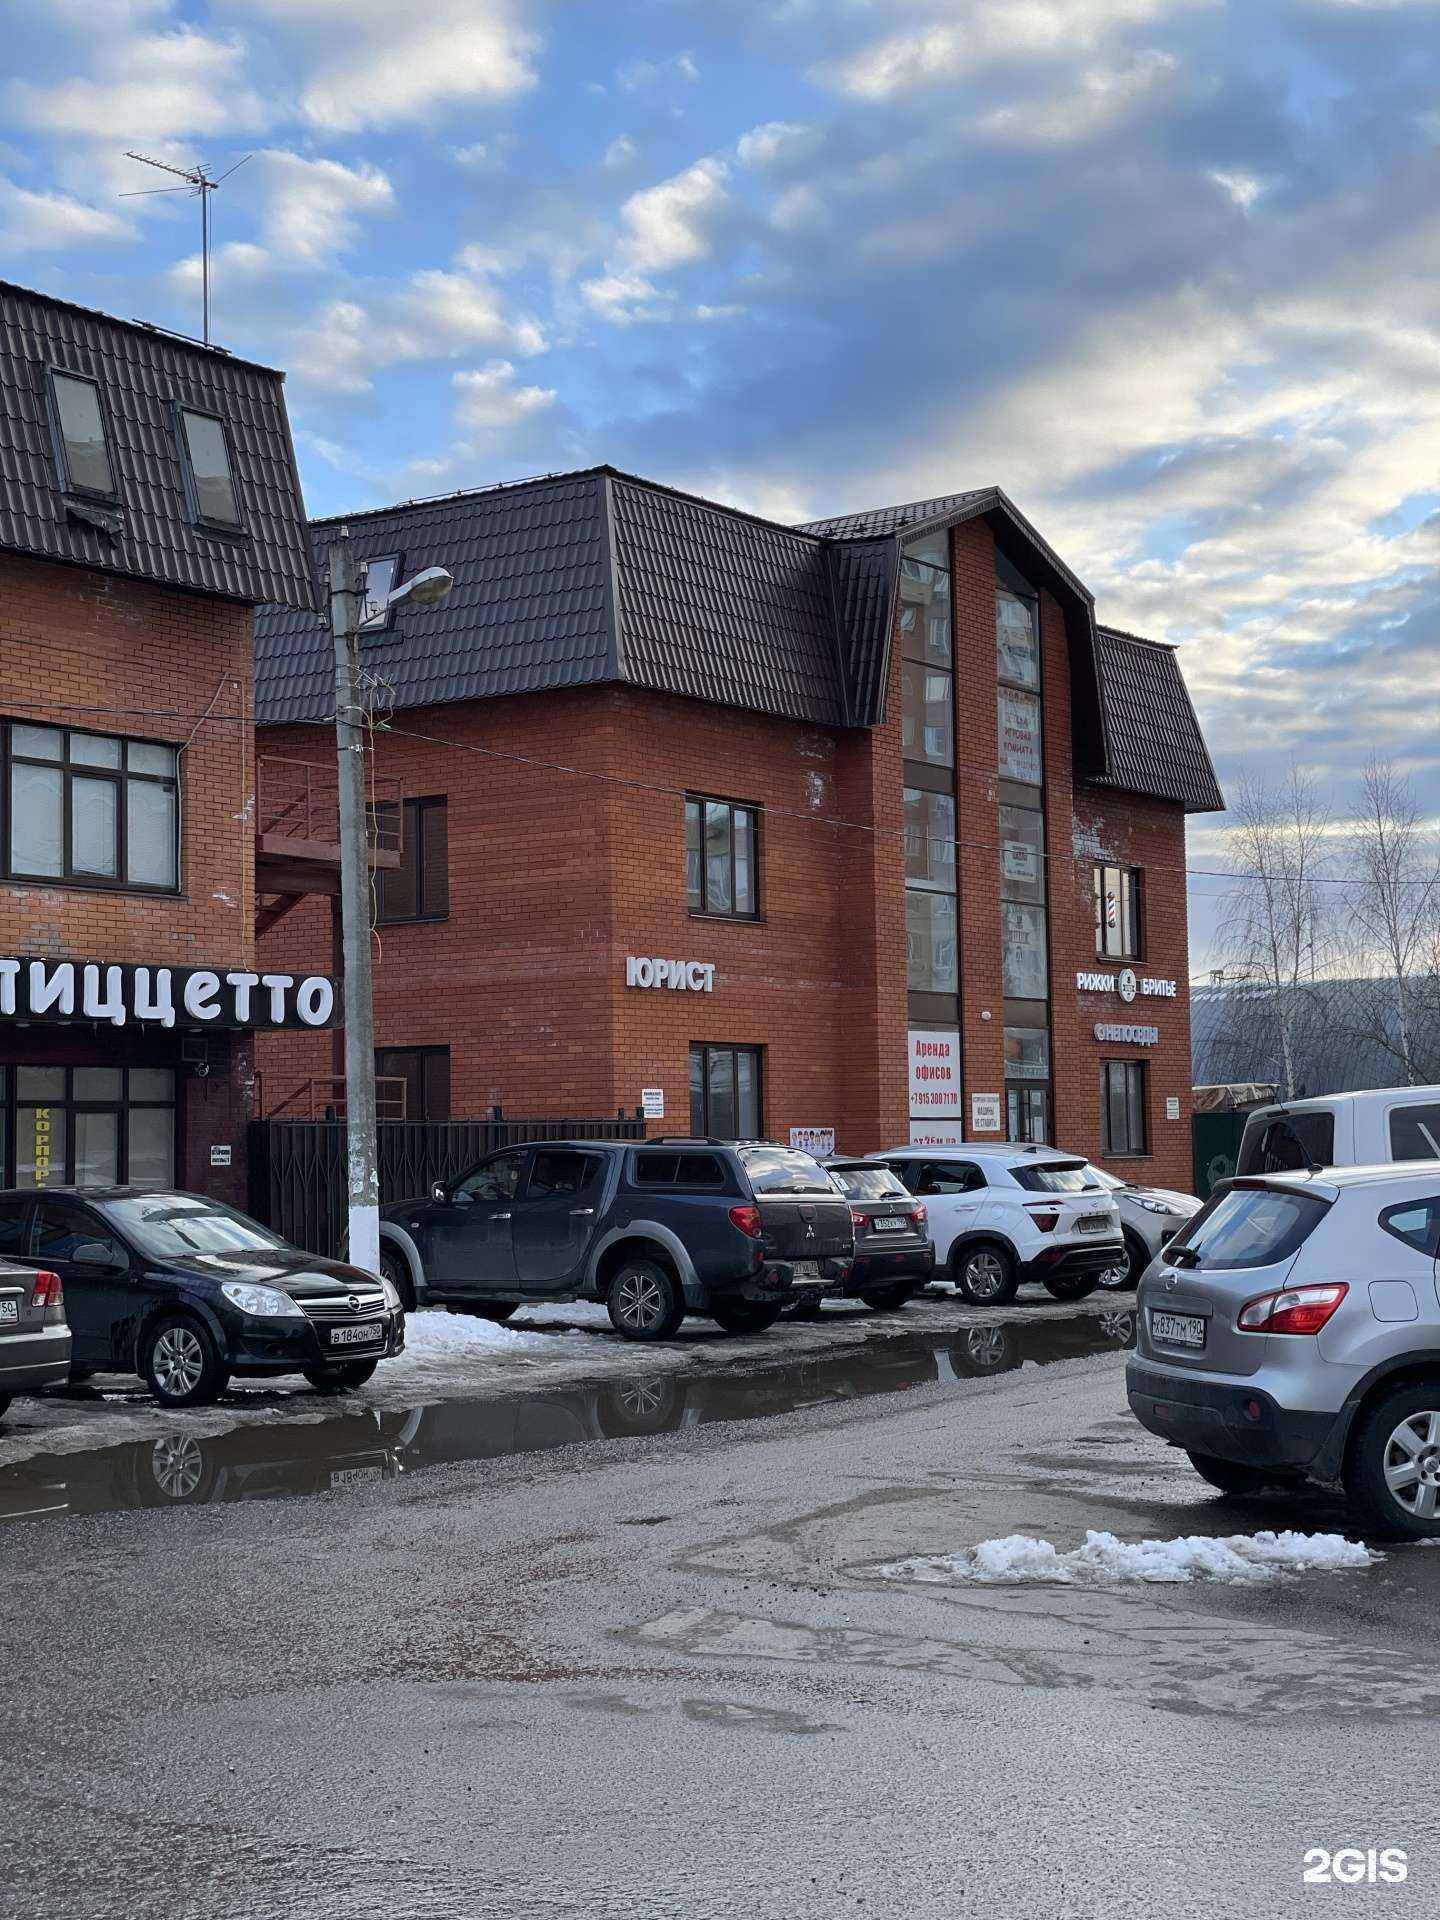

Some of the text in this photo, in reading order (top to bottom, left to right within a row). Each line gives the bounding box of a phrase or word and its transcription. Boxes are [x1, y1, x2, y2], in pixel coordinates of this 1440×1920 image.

[626, 956, 715, 992] ЮРИСТ
[1077, 972, 1115, 992] РИЖКИ
[915, 1039, 951, 1059] Аренда
[915, 1064, 952, 1082] офисов
[35, 1108, 50, 1188] КОРПОР
